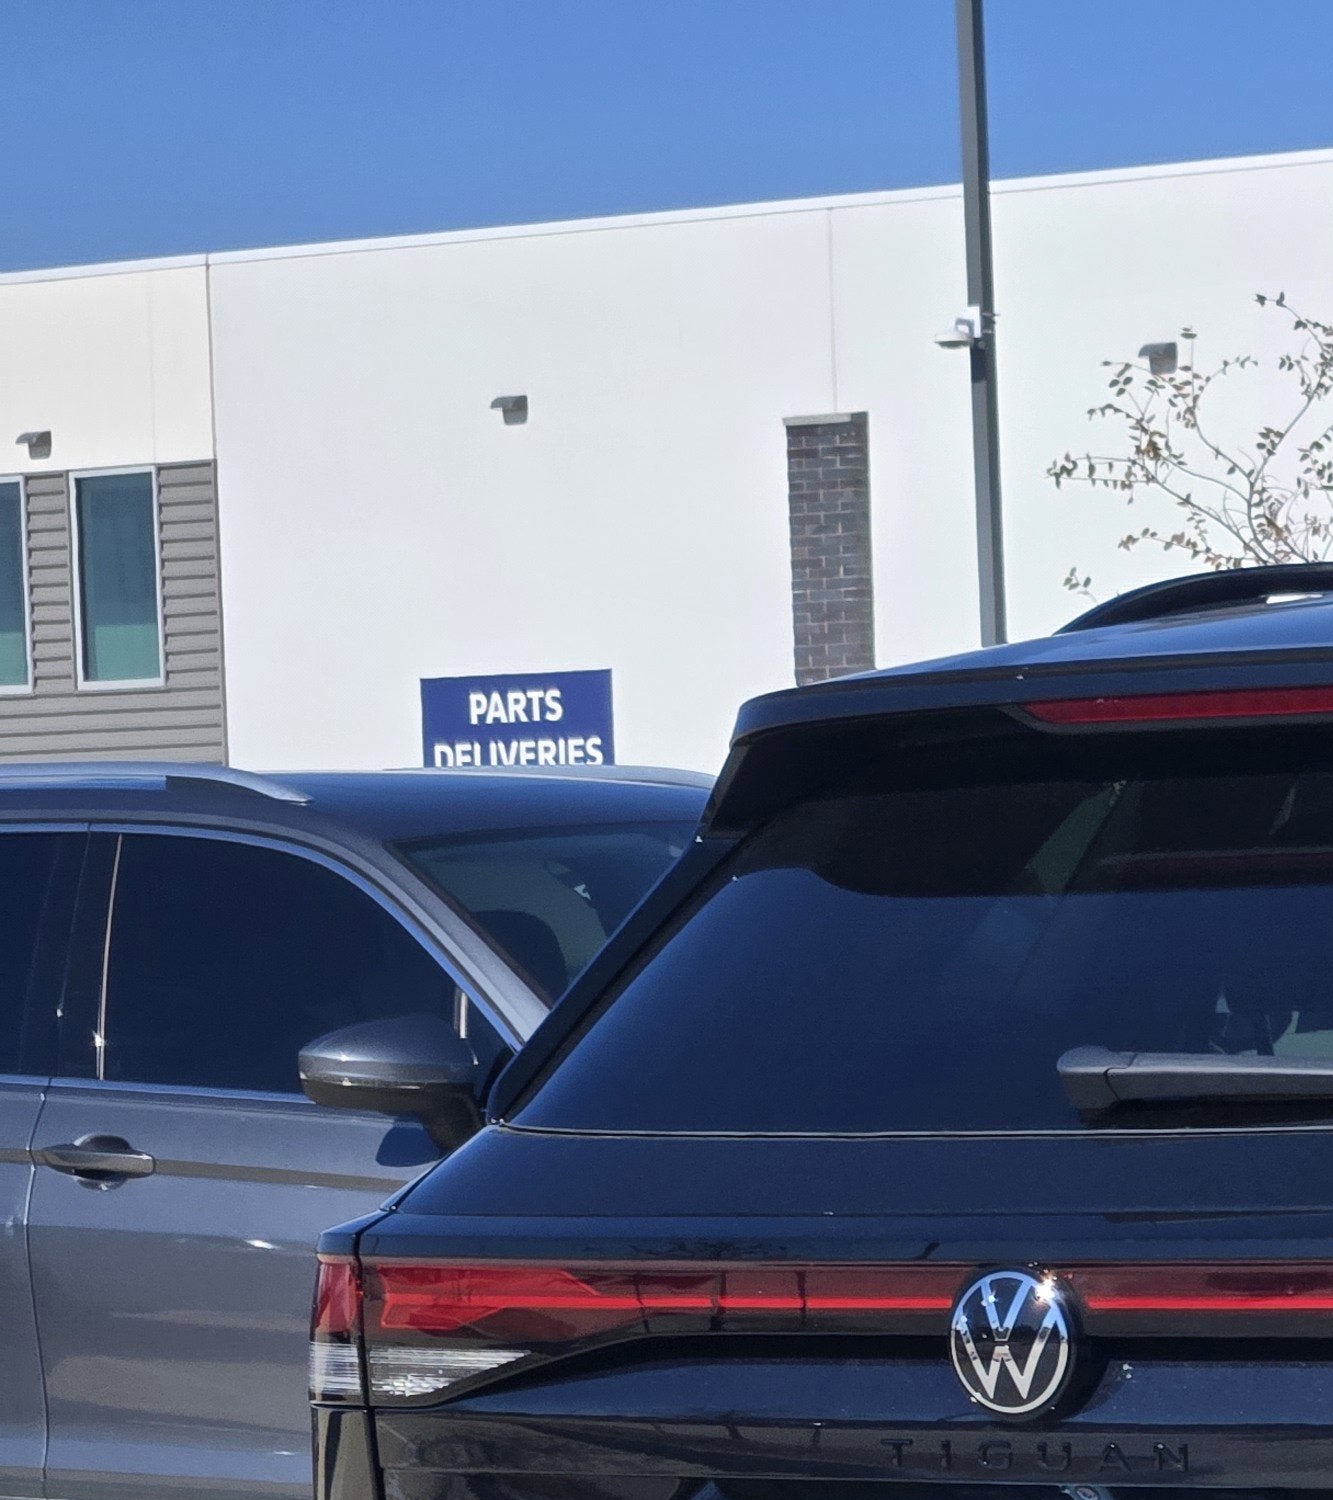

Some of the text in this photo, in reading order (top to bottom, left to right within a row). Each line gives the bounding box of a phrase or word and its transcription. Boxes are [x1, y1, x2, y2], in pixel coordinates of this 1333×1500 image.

[469, 688, 564, 725] PARTS
[951, 1271, 1069, 1415] VW
[880, 1438, 1189, 1473] TIGUAN
